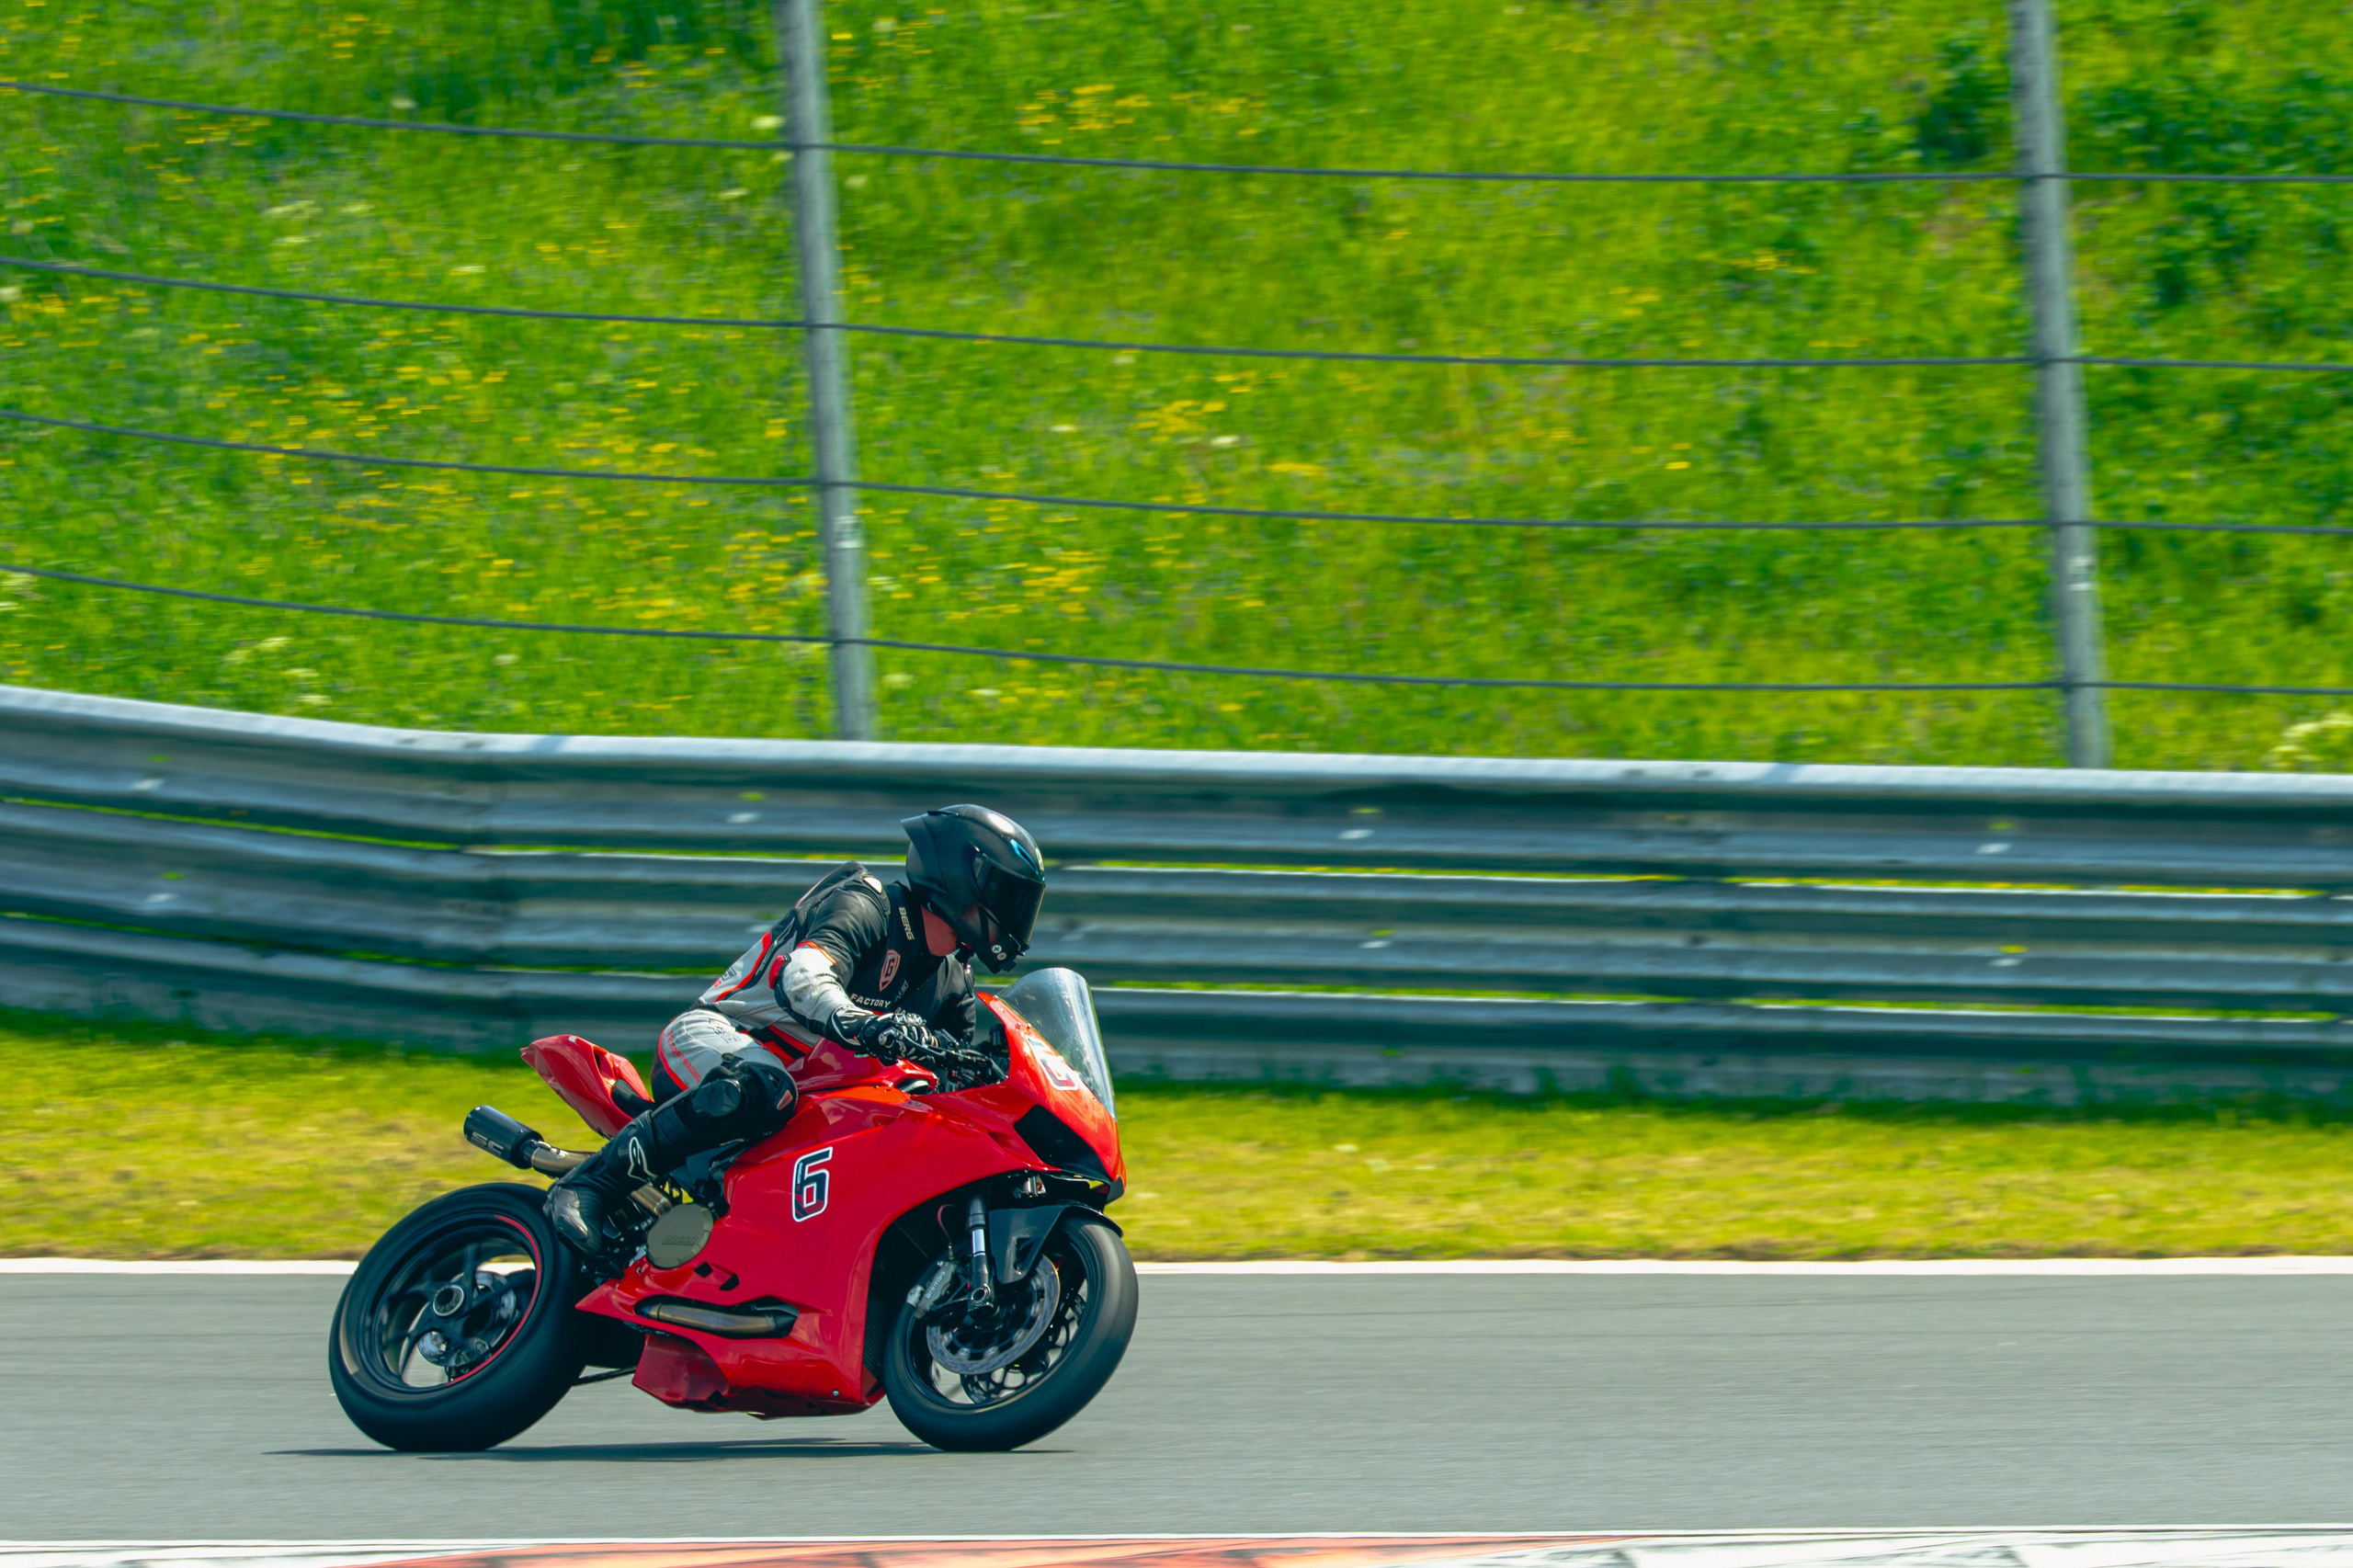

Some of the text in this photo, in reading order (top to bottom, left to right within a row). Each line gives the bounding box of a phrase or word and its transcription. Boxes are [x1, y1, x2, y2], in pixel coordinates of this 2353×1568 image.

[898, 906, 915, 940] BERG
[849, 993, 892, 1008] FACTORY
[792, 1146, 834, 1222] 6
[925, 1271, 946, 1299] brembo
